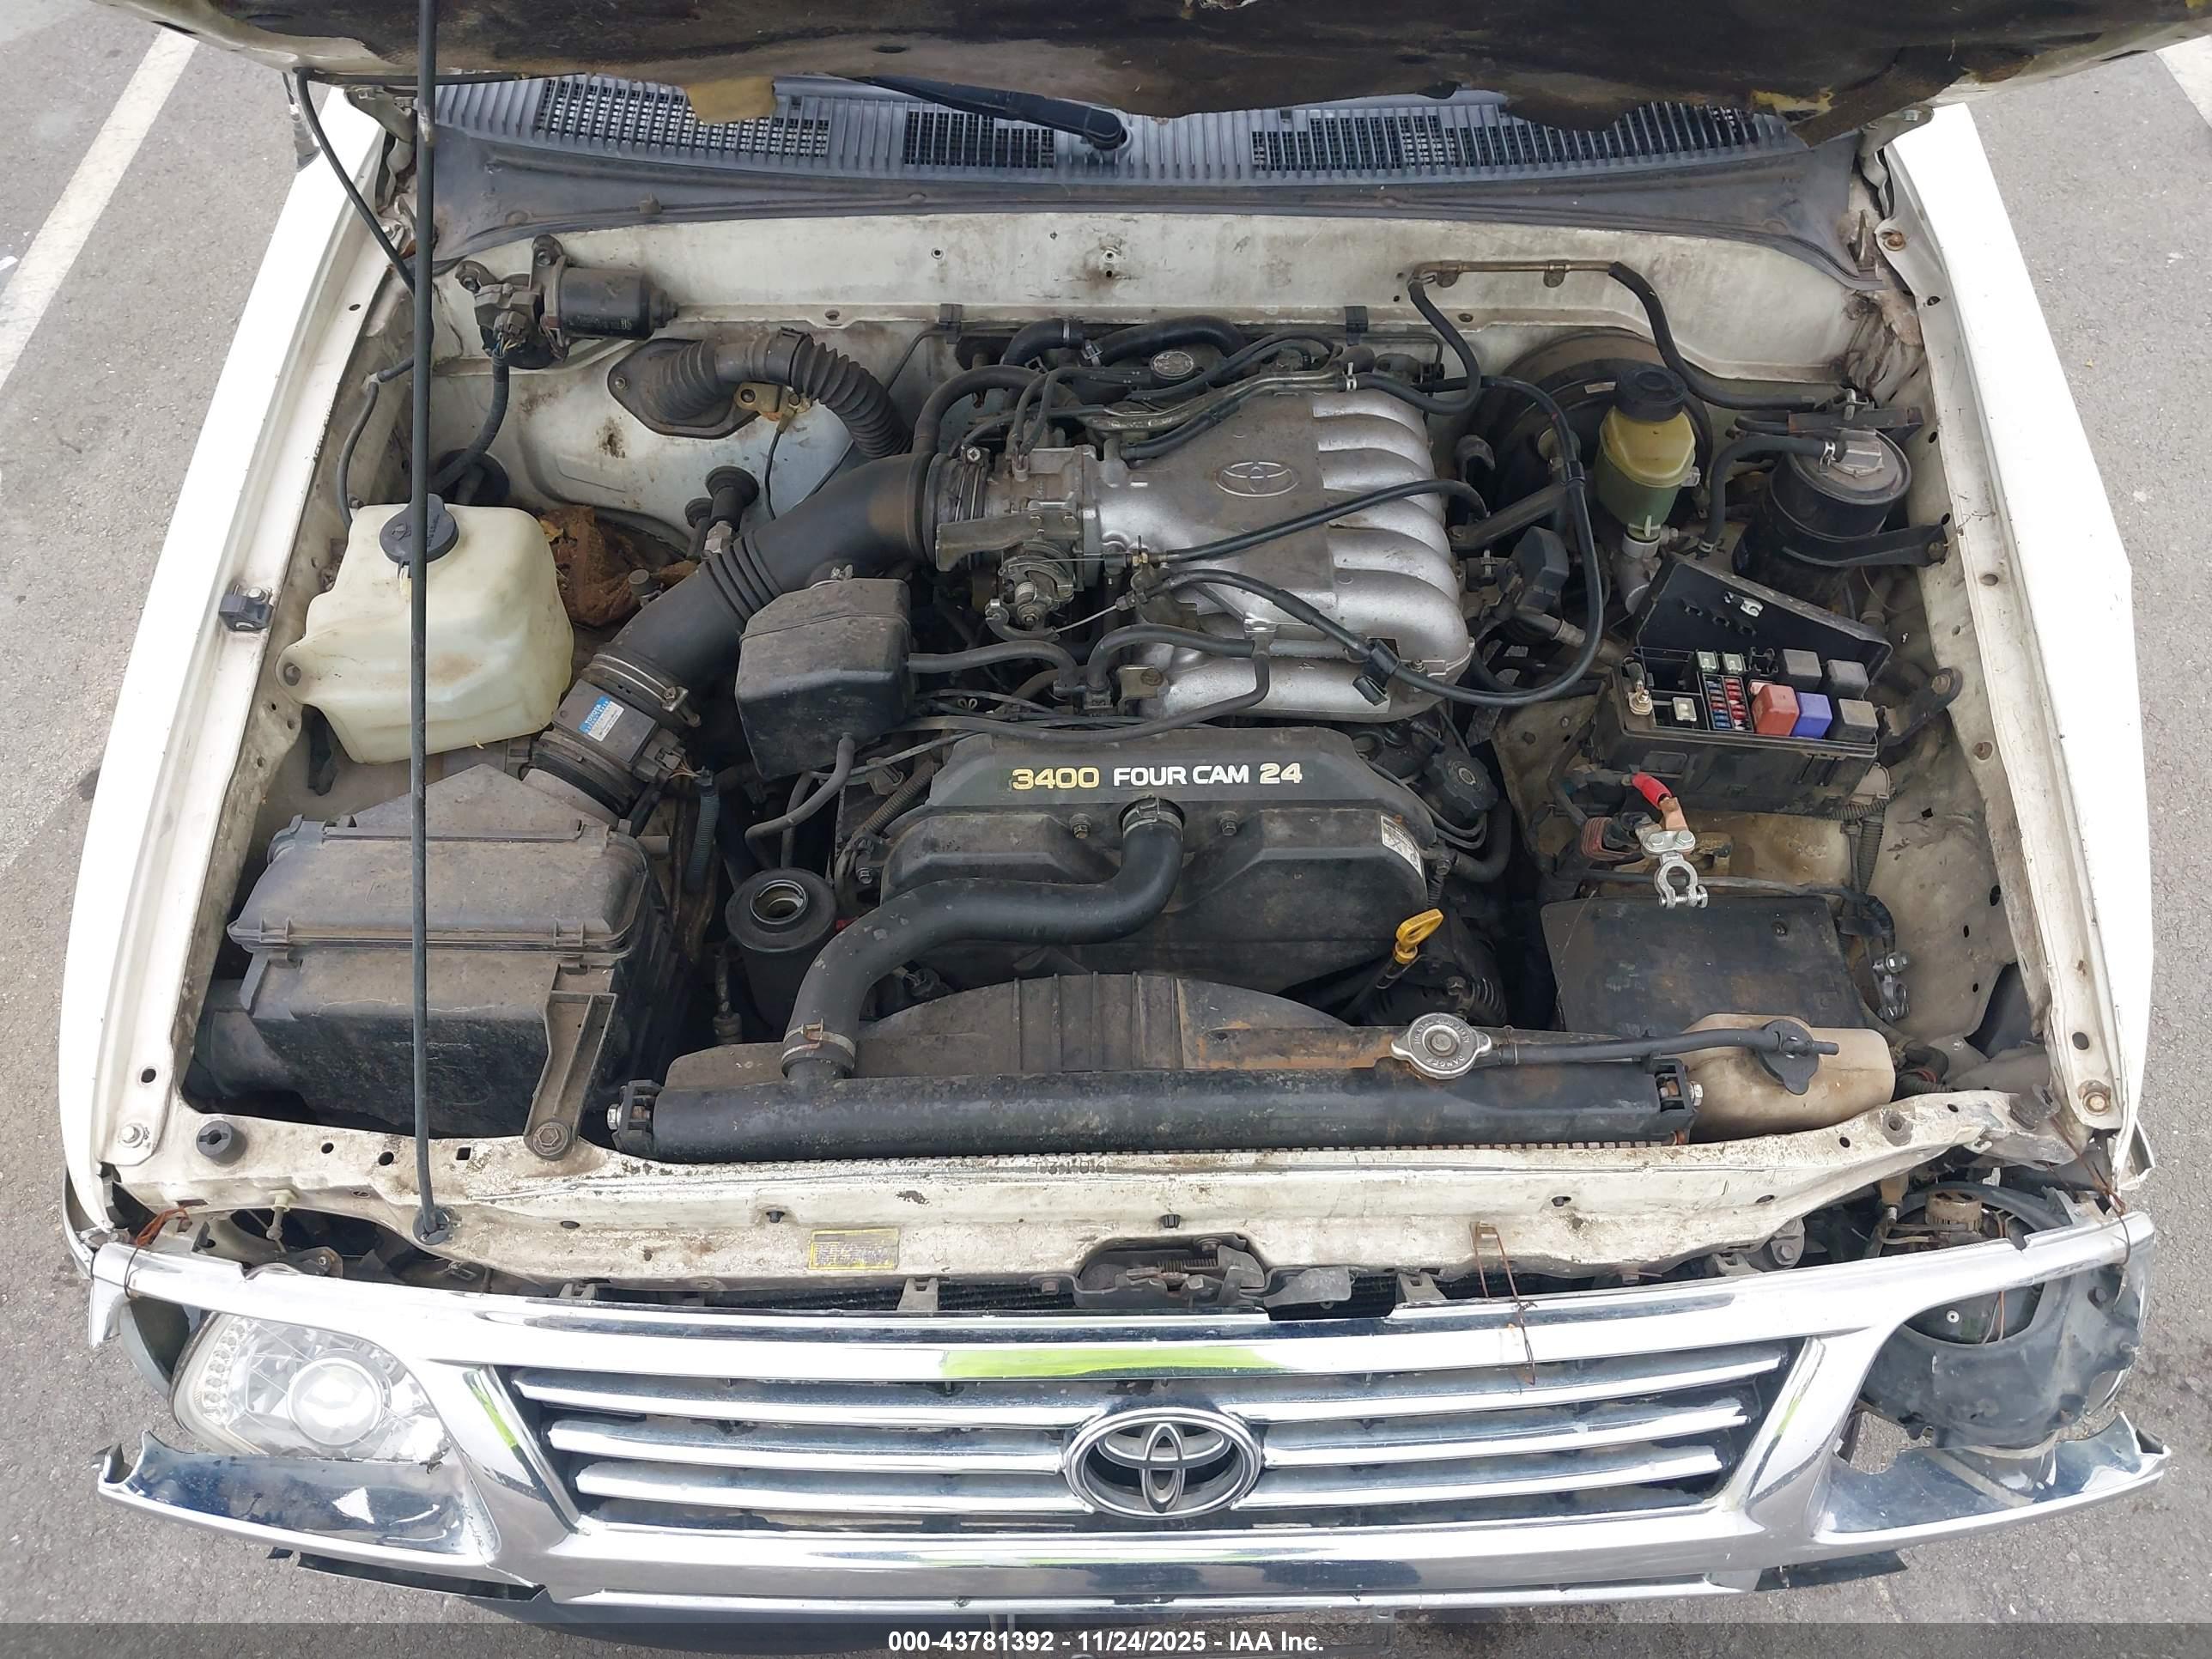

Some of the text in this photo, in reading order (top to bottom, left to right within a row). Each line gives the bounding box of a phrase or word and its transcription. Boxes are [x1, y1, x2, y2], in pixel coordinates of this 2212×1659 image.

[584, 703, 602, 724] TOYOTA
[1012, 763, 1303, 791] 3400 FOUR CAM 24
